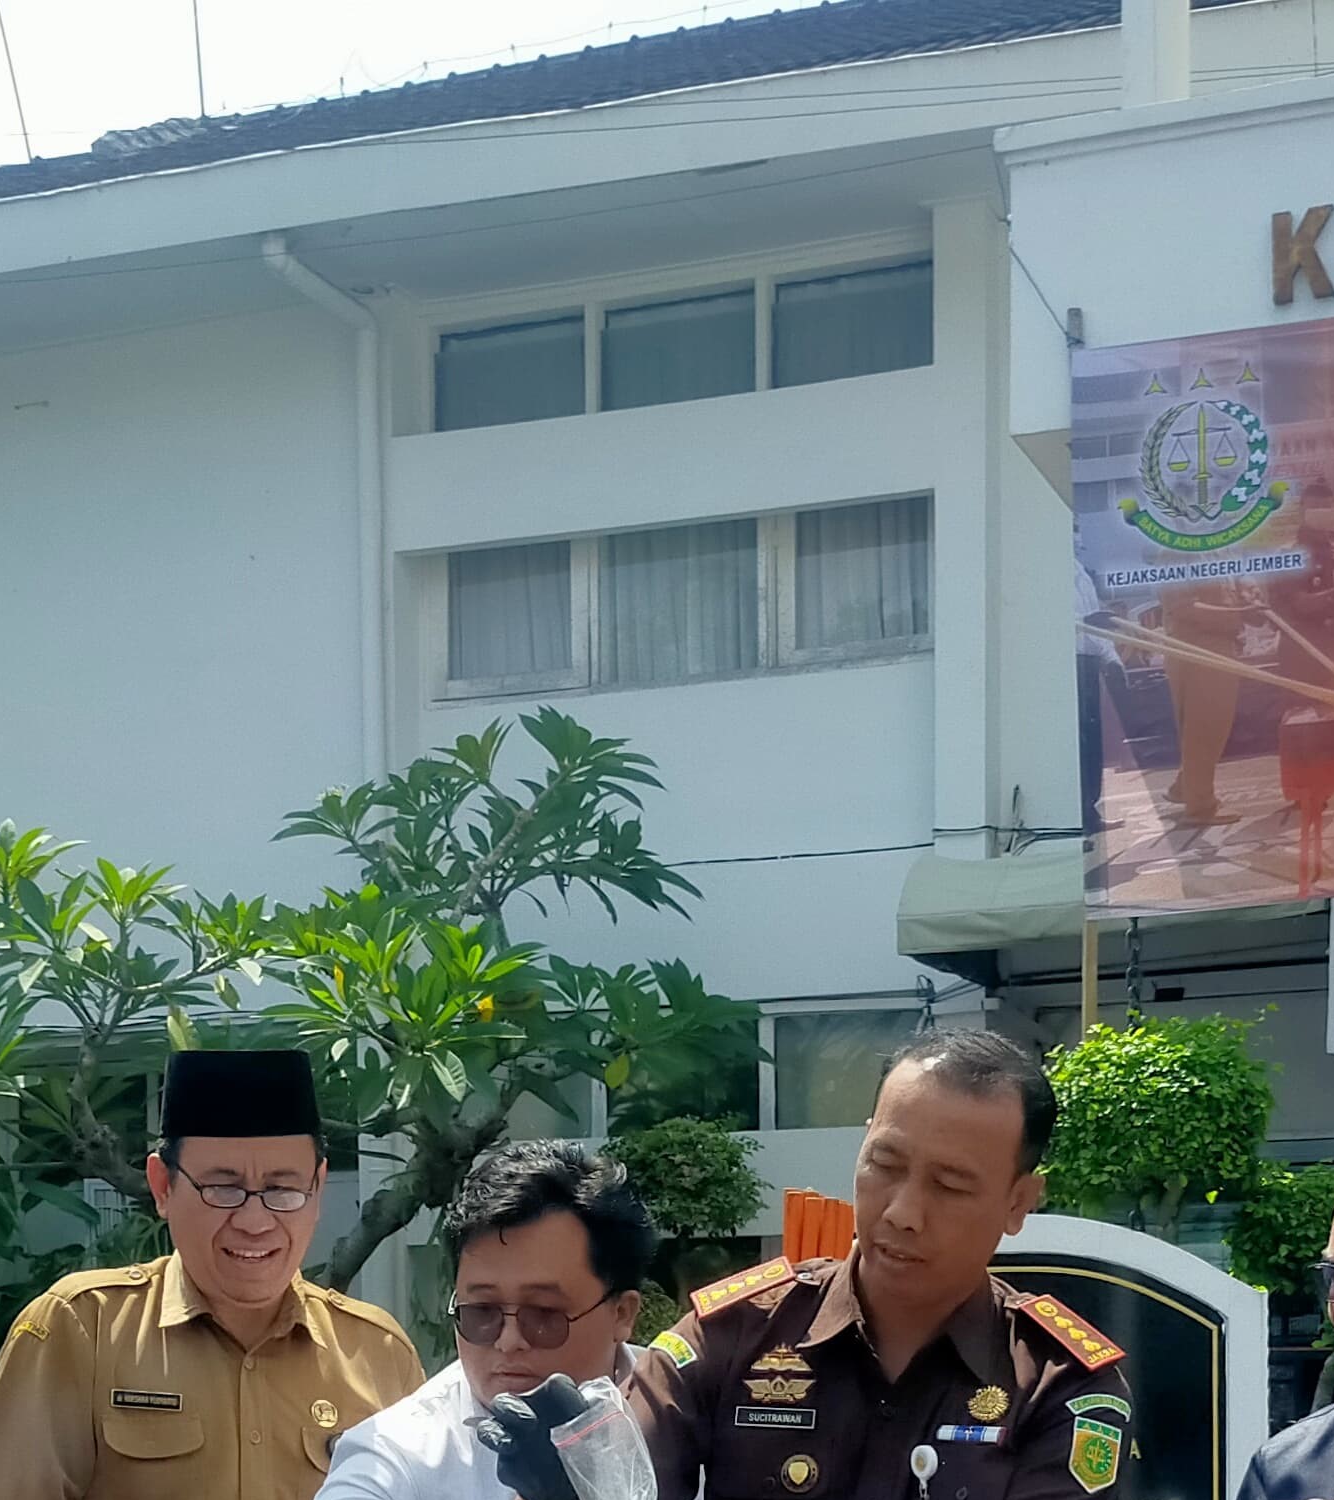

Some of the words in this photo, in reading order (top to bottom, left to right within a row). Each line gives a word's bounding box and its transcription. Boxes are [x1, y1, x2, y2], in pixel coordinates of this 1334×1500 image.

[1106, 566, 1186, 587] KEJAKSAAN
[1190, 559, 1242, 578] NEGERI
[1246, 553, 1302, 573] JEMBER
